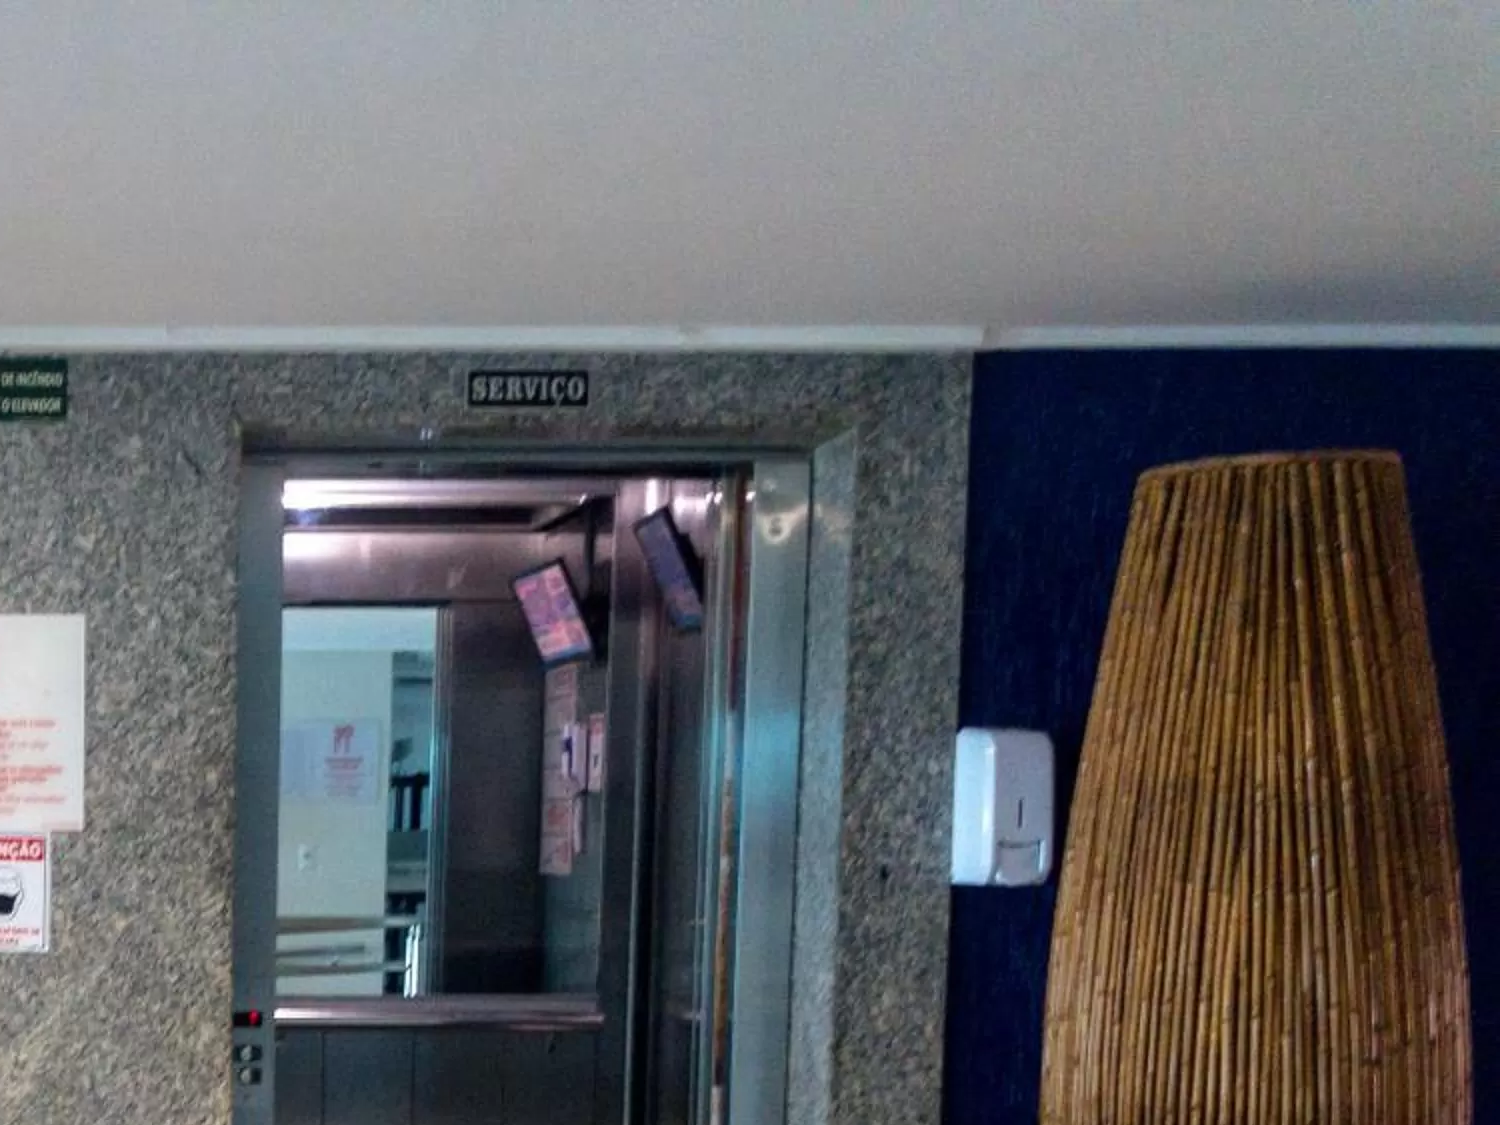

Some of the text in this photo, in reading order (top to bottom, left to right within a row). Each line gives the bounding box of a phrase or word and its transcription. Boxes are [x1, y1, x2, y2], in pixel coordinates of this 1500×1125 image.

[1, 371, 15, 387] DE
[471, 375, 585, 406] SERVIÇO
[1, 398, 11, 413] O
[12, 397, 61, 413] ELEVADOR
